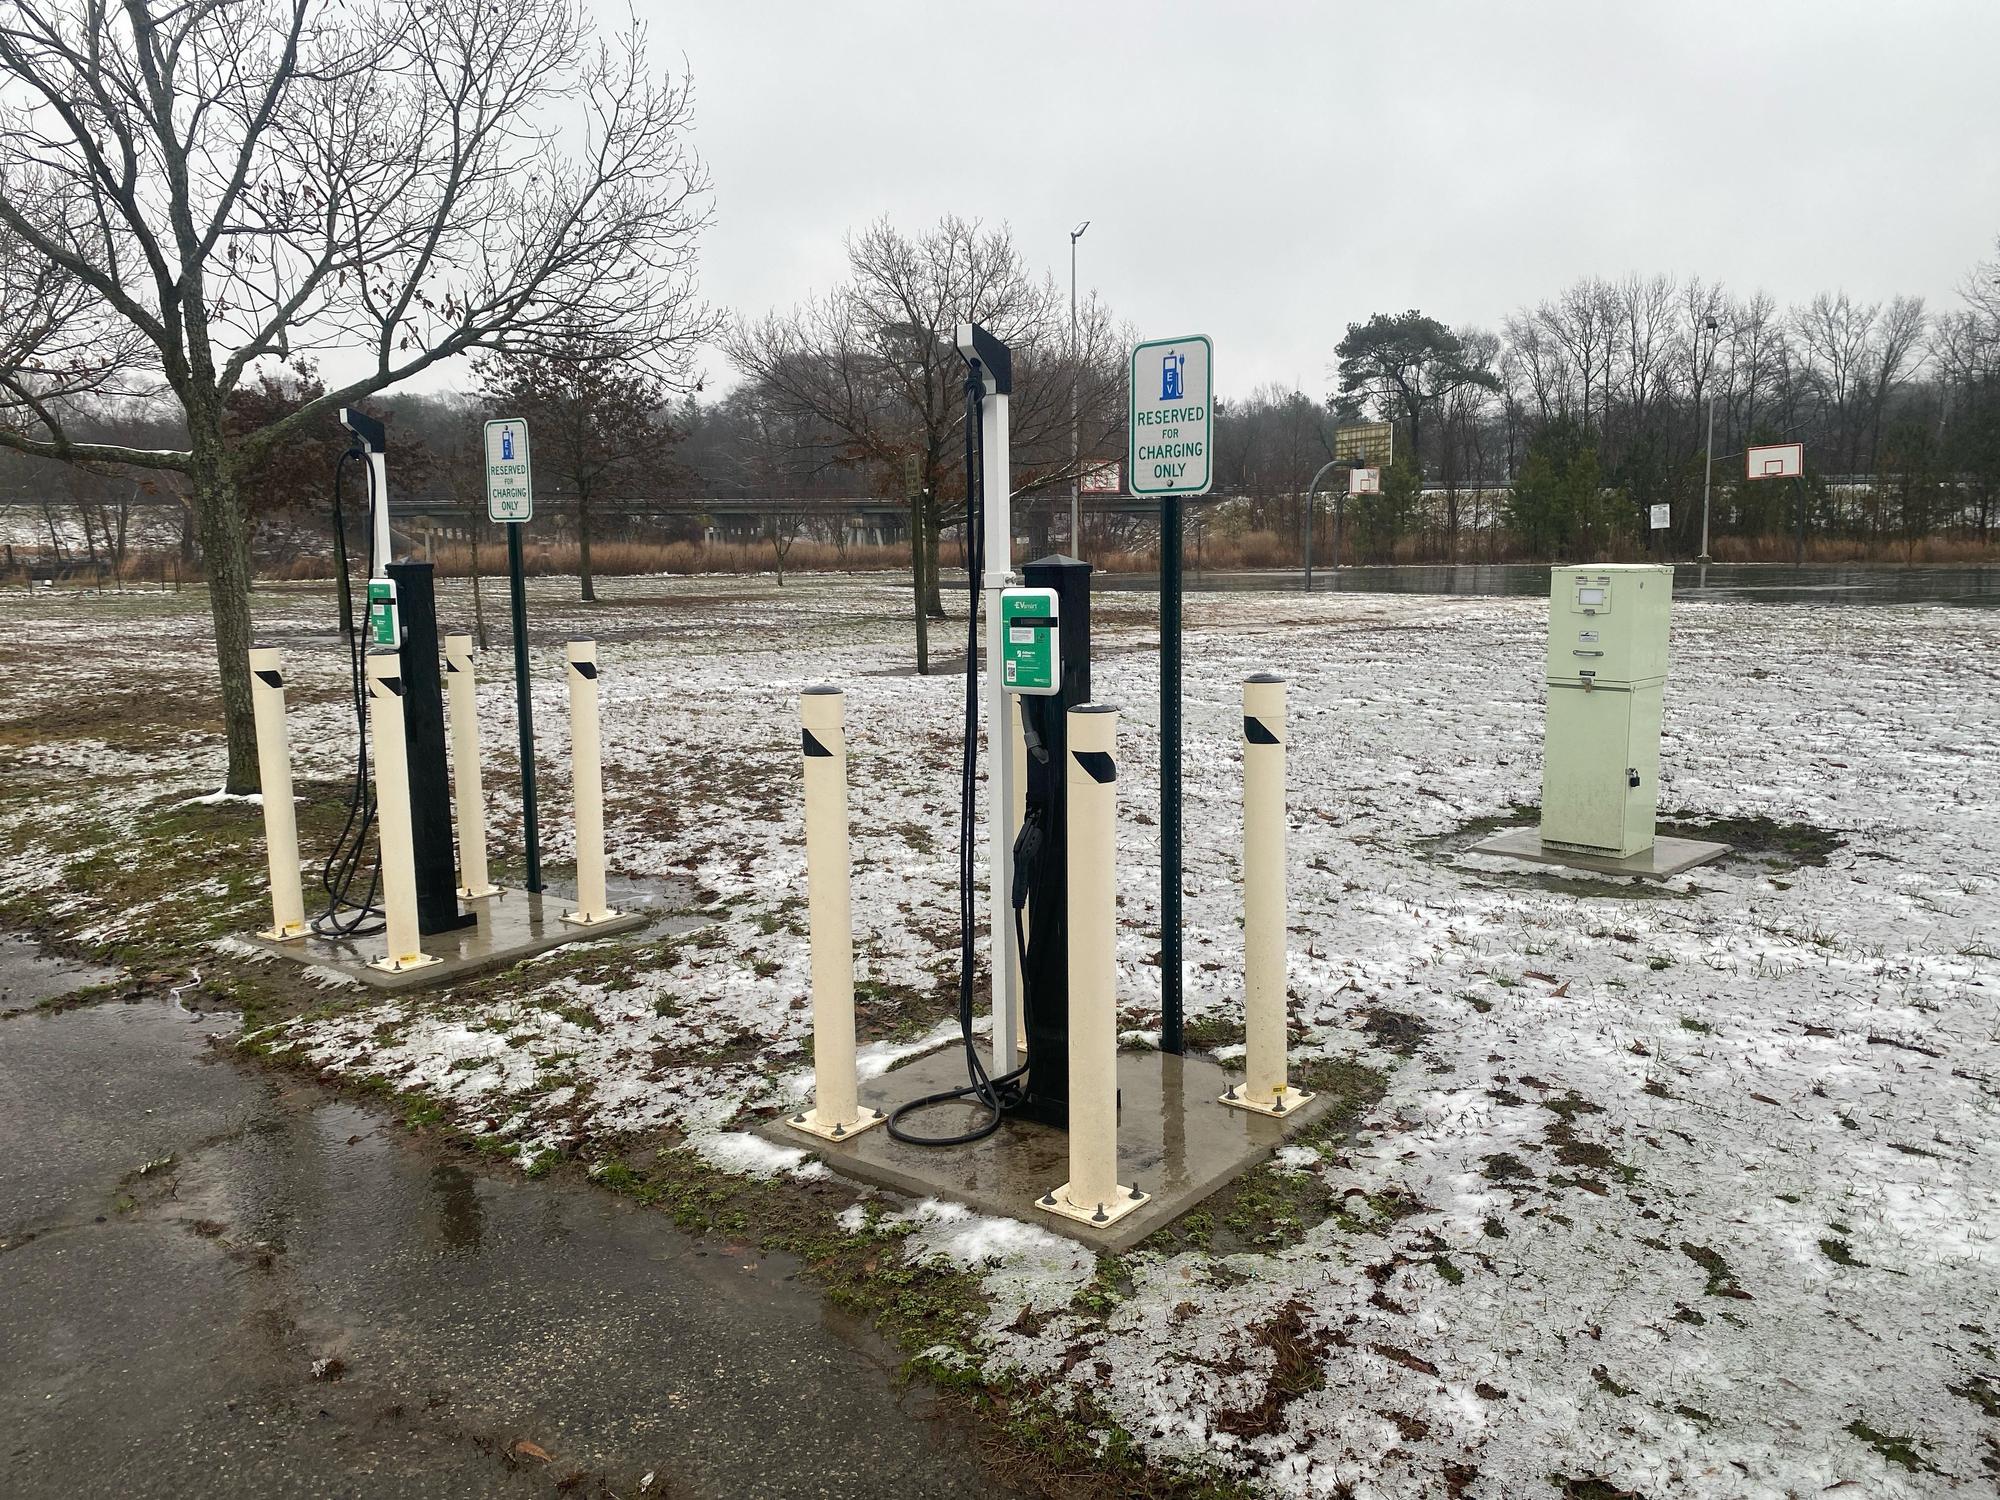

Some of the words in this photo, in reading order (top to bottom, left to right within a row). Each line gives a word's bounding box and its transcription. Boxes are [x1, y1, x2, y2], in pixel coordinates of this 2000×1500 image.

[1137, 407, 1204, 426] RESERVED
[1162, 428, 1179, 439] FOR
[1138, 442, 1203, 460] CHARGING
[490, 464, 526, 476] RESERVED
[1153, 463, 1187, 478] ONLY
[492, 487, 527, 498] CHARGING
[501, 501, 519, 510] ONLY
